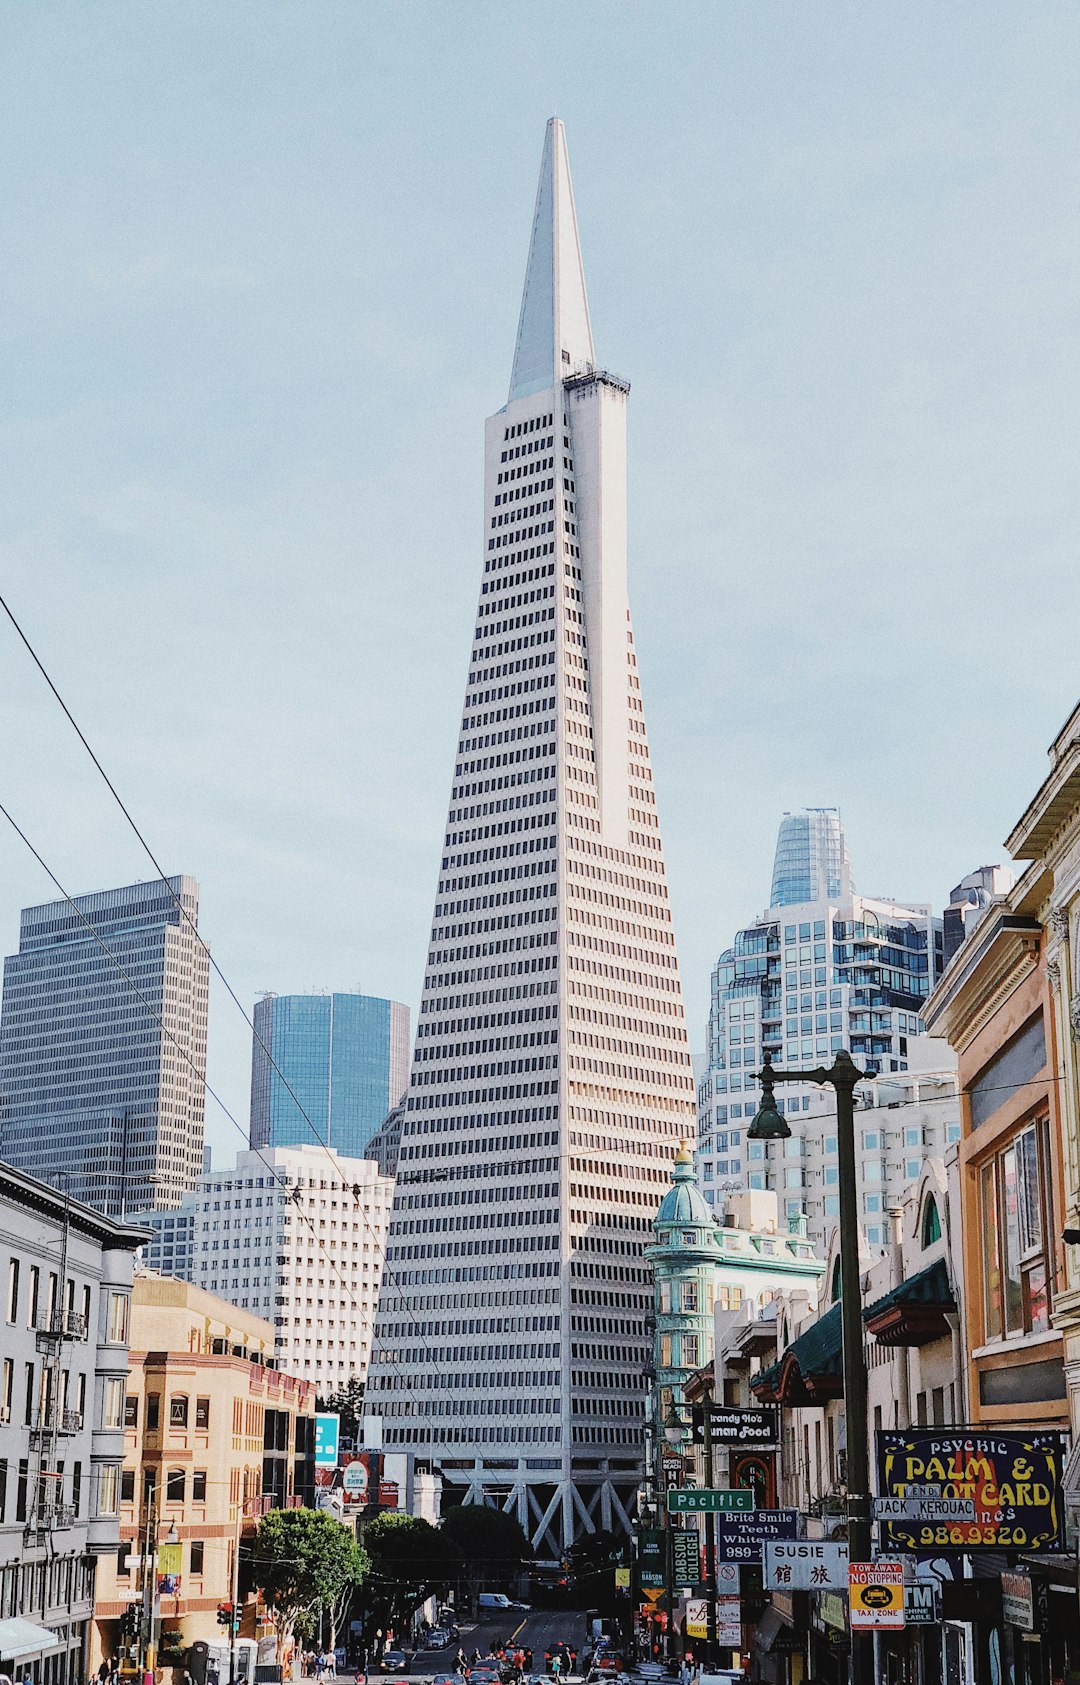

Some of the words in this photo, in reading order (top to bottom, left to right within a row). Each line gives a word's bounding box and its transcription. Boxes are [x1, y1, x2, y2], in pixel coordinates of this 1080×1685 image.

[710, 1414, 740, 1424] randy
[741, 1414, 763, 1423] Ho's
[738, 1425, 771, 1439] Food
[930, 1439, 1008, 1455] PSYCHIC
[905, 1457, 993, 1480] PALM
[1011, 1457, 1035, 1481] &
[893, 1483, 977, 1499] TOT
[981, 1483, 1051, 1507] CARD
[912, 1488, 936, 1496] END
[677, 1494, 744, 1507] Pacific
[877, 1500, 908, 1514] JACK
[920, 1500, 974, 1515] KEROUAC
[725, 1512, 755, 1523] Brite
[758, 1512, 793, 1523] Smile
[738, 1524, 779, 1534] Teeth
[674, 1536, 689, 1581] BABSON
[687, 1536, 700, 1581] COLLEGE
[774, 1546, 824, 1558] SUSIE
[773, 1564, 793, 1584] 館
[809, 1564, 832, 1584] 旅
[853, 1564, 898, 1572] TOW-AWAY
[851, 1573, 867, 1584] NO
[868, 1573, 903, 1584] STOPPING
[904, 1586, 932, 1608] TM
[857, 1609, 875, 1617] TAXI
[877, 1609, 899, 1617] ZONE
